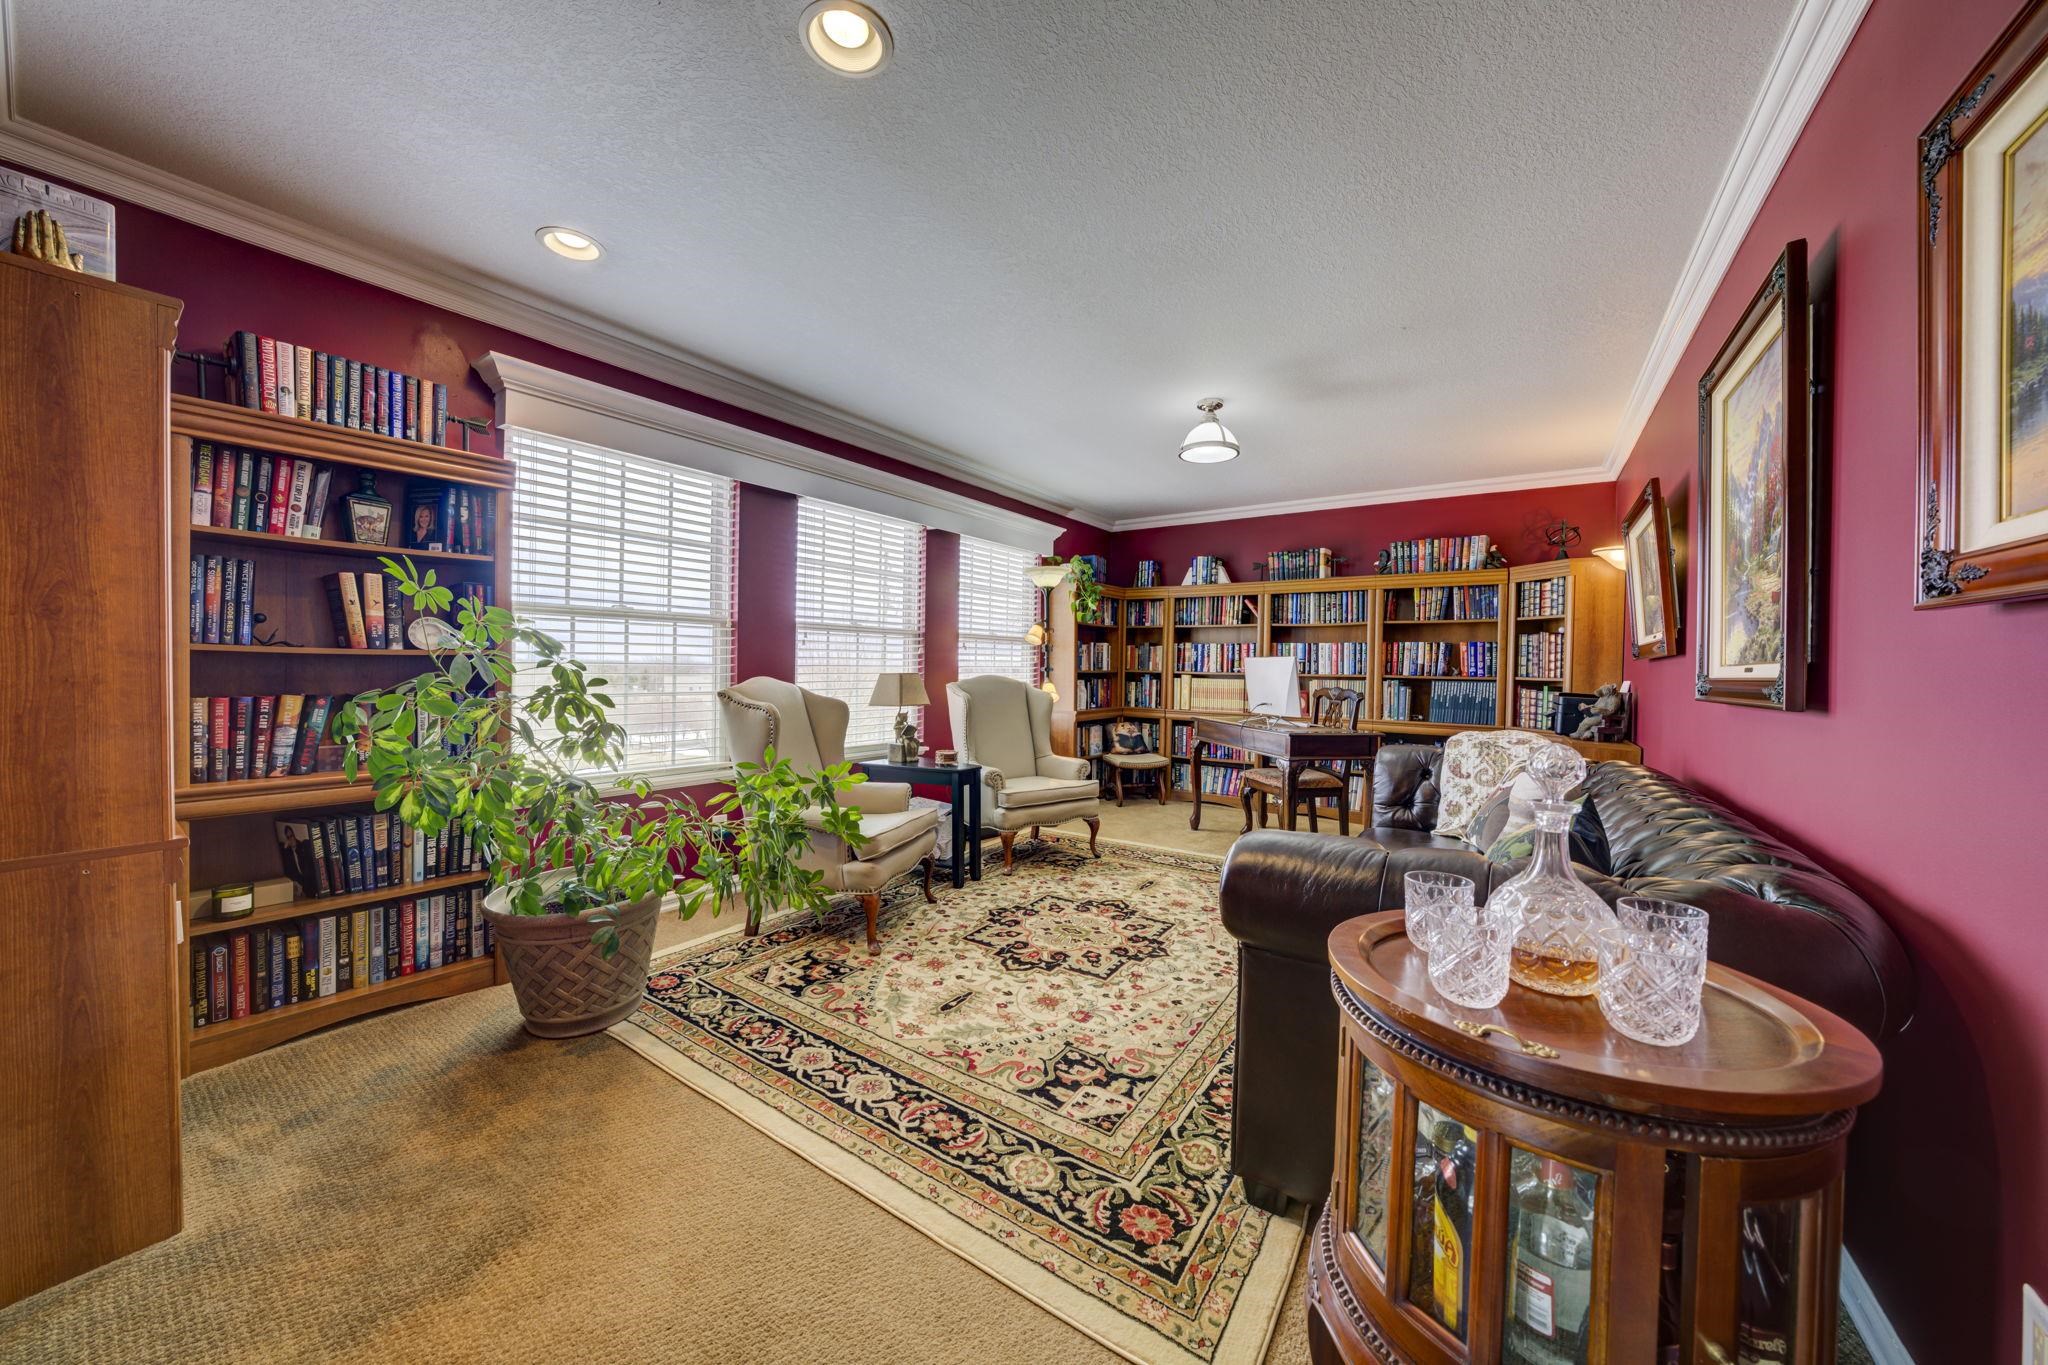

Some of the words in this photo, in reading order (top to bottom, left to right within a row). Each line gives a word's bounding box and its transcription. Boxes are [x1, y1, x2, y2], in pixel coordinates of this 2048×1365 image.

[262, 339, 274, 362] DAVID
[299, 350, 310, 369] DAVID
[335, 360, 343, 375] DAVID
[263, 362, 275, 399] BALDACCI
[299, 370, 310, 402] BALDACCI
[351, 369, 359, 387] DAVID
[393, 374, 401, 391] DAVID
[298, 403, 306, 417] MAN
[350, 387, 359, 415] BALDACCI
[393, 392, 401, 419] BALDACCI
[297, 472, 305, 482] LAST
[293, 484, 303, 502] TEMPLAR
[207, 570, 215, 594] SURVIVOR
[193, 703, 202, 724] SAVAGE
[216, 703, 224, 716] TRUE
[261, 699, 269, 712] JACK
[286, 699, 295, 709] JACK
[259, 715, 268, 728] CARR
[283, 712, 291, 725] CARR
[193, 725, 202, 736] SON
[215, 719, 224, 743] BELIEVER
[194, 742, 202, 753] JACK
[236, 735, 245, 754] DEVIL'S
[193, 756, 202, 768] CARR
[427, 838, 436, 848] THE
[447, 896, 455, 912] DAVID
[403, 904, 413, 924] DAVID
[322, 920, 332, 939] DAVID
[446, 913, 456, 939] BALDACCI
[236, 937, 245, 956] DAVID
[273, 936, 282, 954] DAVID
[403, 925, 413, 955] BALDACCI
[322, 939, 332, 968] BALDACCI
[236, 956, 245, 984] BALDACCI
[273, 955, 282, 982] BALDACCI
[216, 981, 224, 1008] FINISHER
[237, 992, 245, 1010] TARGET
